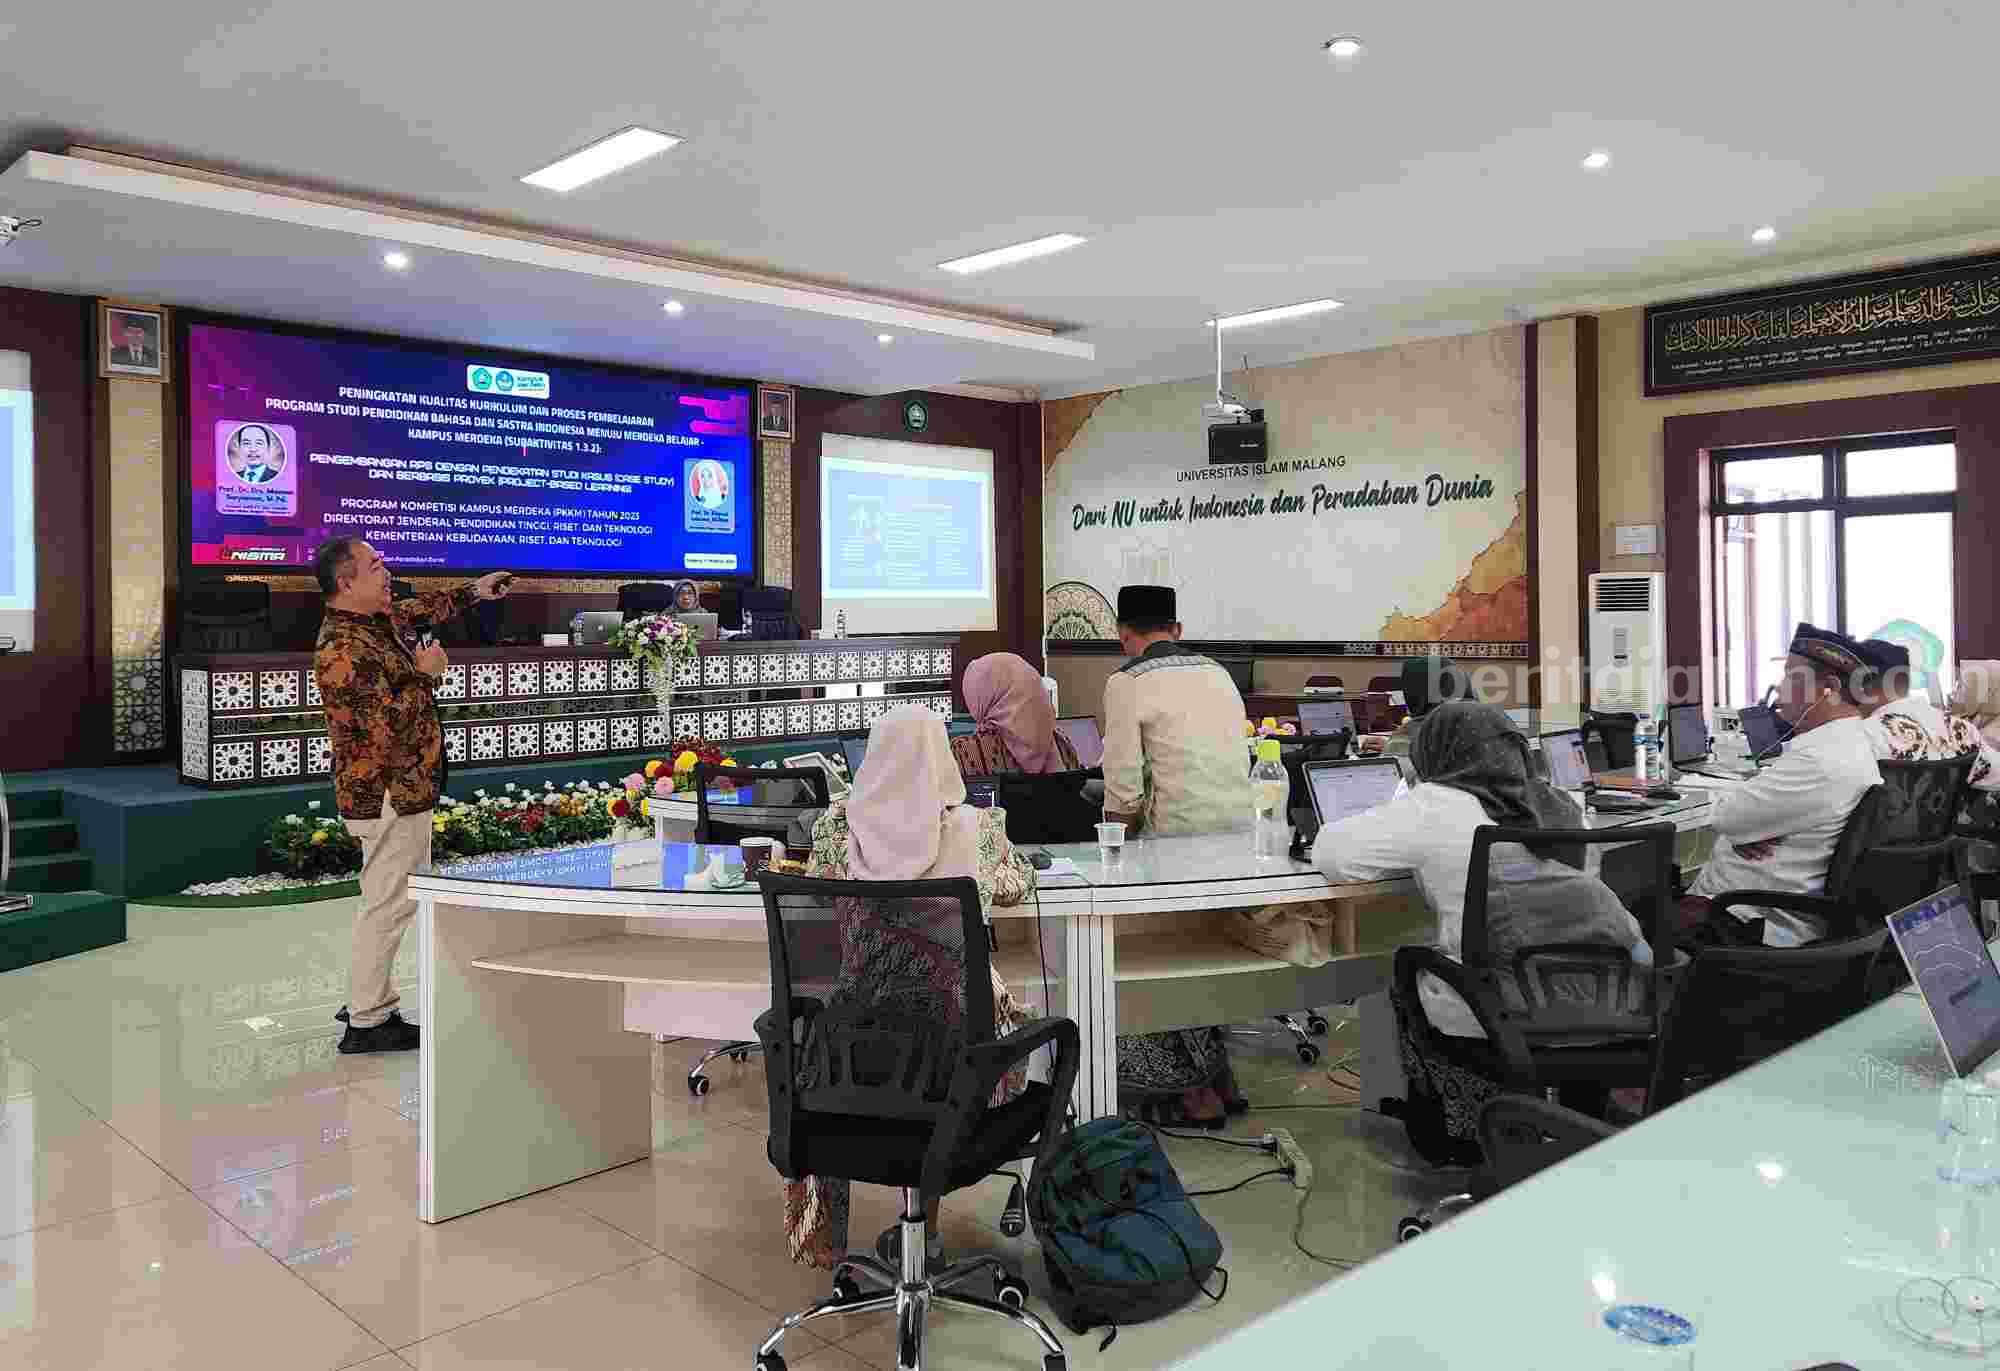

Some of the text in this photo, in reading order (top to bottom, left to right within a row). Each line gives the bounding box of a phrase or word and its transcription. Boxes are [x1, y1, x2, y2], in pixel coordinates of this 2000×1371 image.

[338, 386, 655, 428] PENINGKATAN KUALITAS KURIKULUM DAN PROSES PEMBELAJARAN
[265, 397, 324, 413] PROGRAM
[327, 403, 360, 417] STUDI
[362, 406, 428, 422] PENDIDIKAN
[431, 413, 472, 426] BAHASA
[474, 416, 495, 428] DAN
[497, 419, 534, 433] SASTRA
[535, 421, 585, 436] INDONESIA
[624, 428, 665, 444] MERDEKA
[666, 433, 699, 446] BELAJAR
[408, 428, 452, 442] KAMPUS
[454, 433, 502, 446] MERDEKA
[368, 469, 394, 480] DAN
[453, 474, 496, 485] PROYEK
[551, 469, 579, 480] STUDI
[1176, 455, 1346, 482] UNIVERSITAS ISLAM MALANG
[340, 498, 398, 510] PROGRAM
[400, 501, 457, 513] KOMPETISI
[459, 503, 504, 515] KAMPUS
[504, 505, 551, 518] MERDEKA
[587, 510, 619, 520] TAHUN
[1072, 473, 1495, 531] Dari NU untuk Indonesia dan Peradaban Dunia
[323, 513, 395, 526] DIREKTORAT
[396, 515, 452, 528] JENDERAL
[454, 518, 516, 530] PENDIDIKAN
[582, 523, 602, 533] DAN
[365, 530, 443, 542] KEMENTERIAN
[549, 536, 569, 546] DAN
